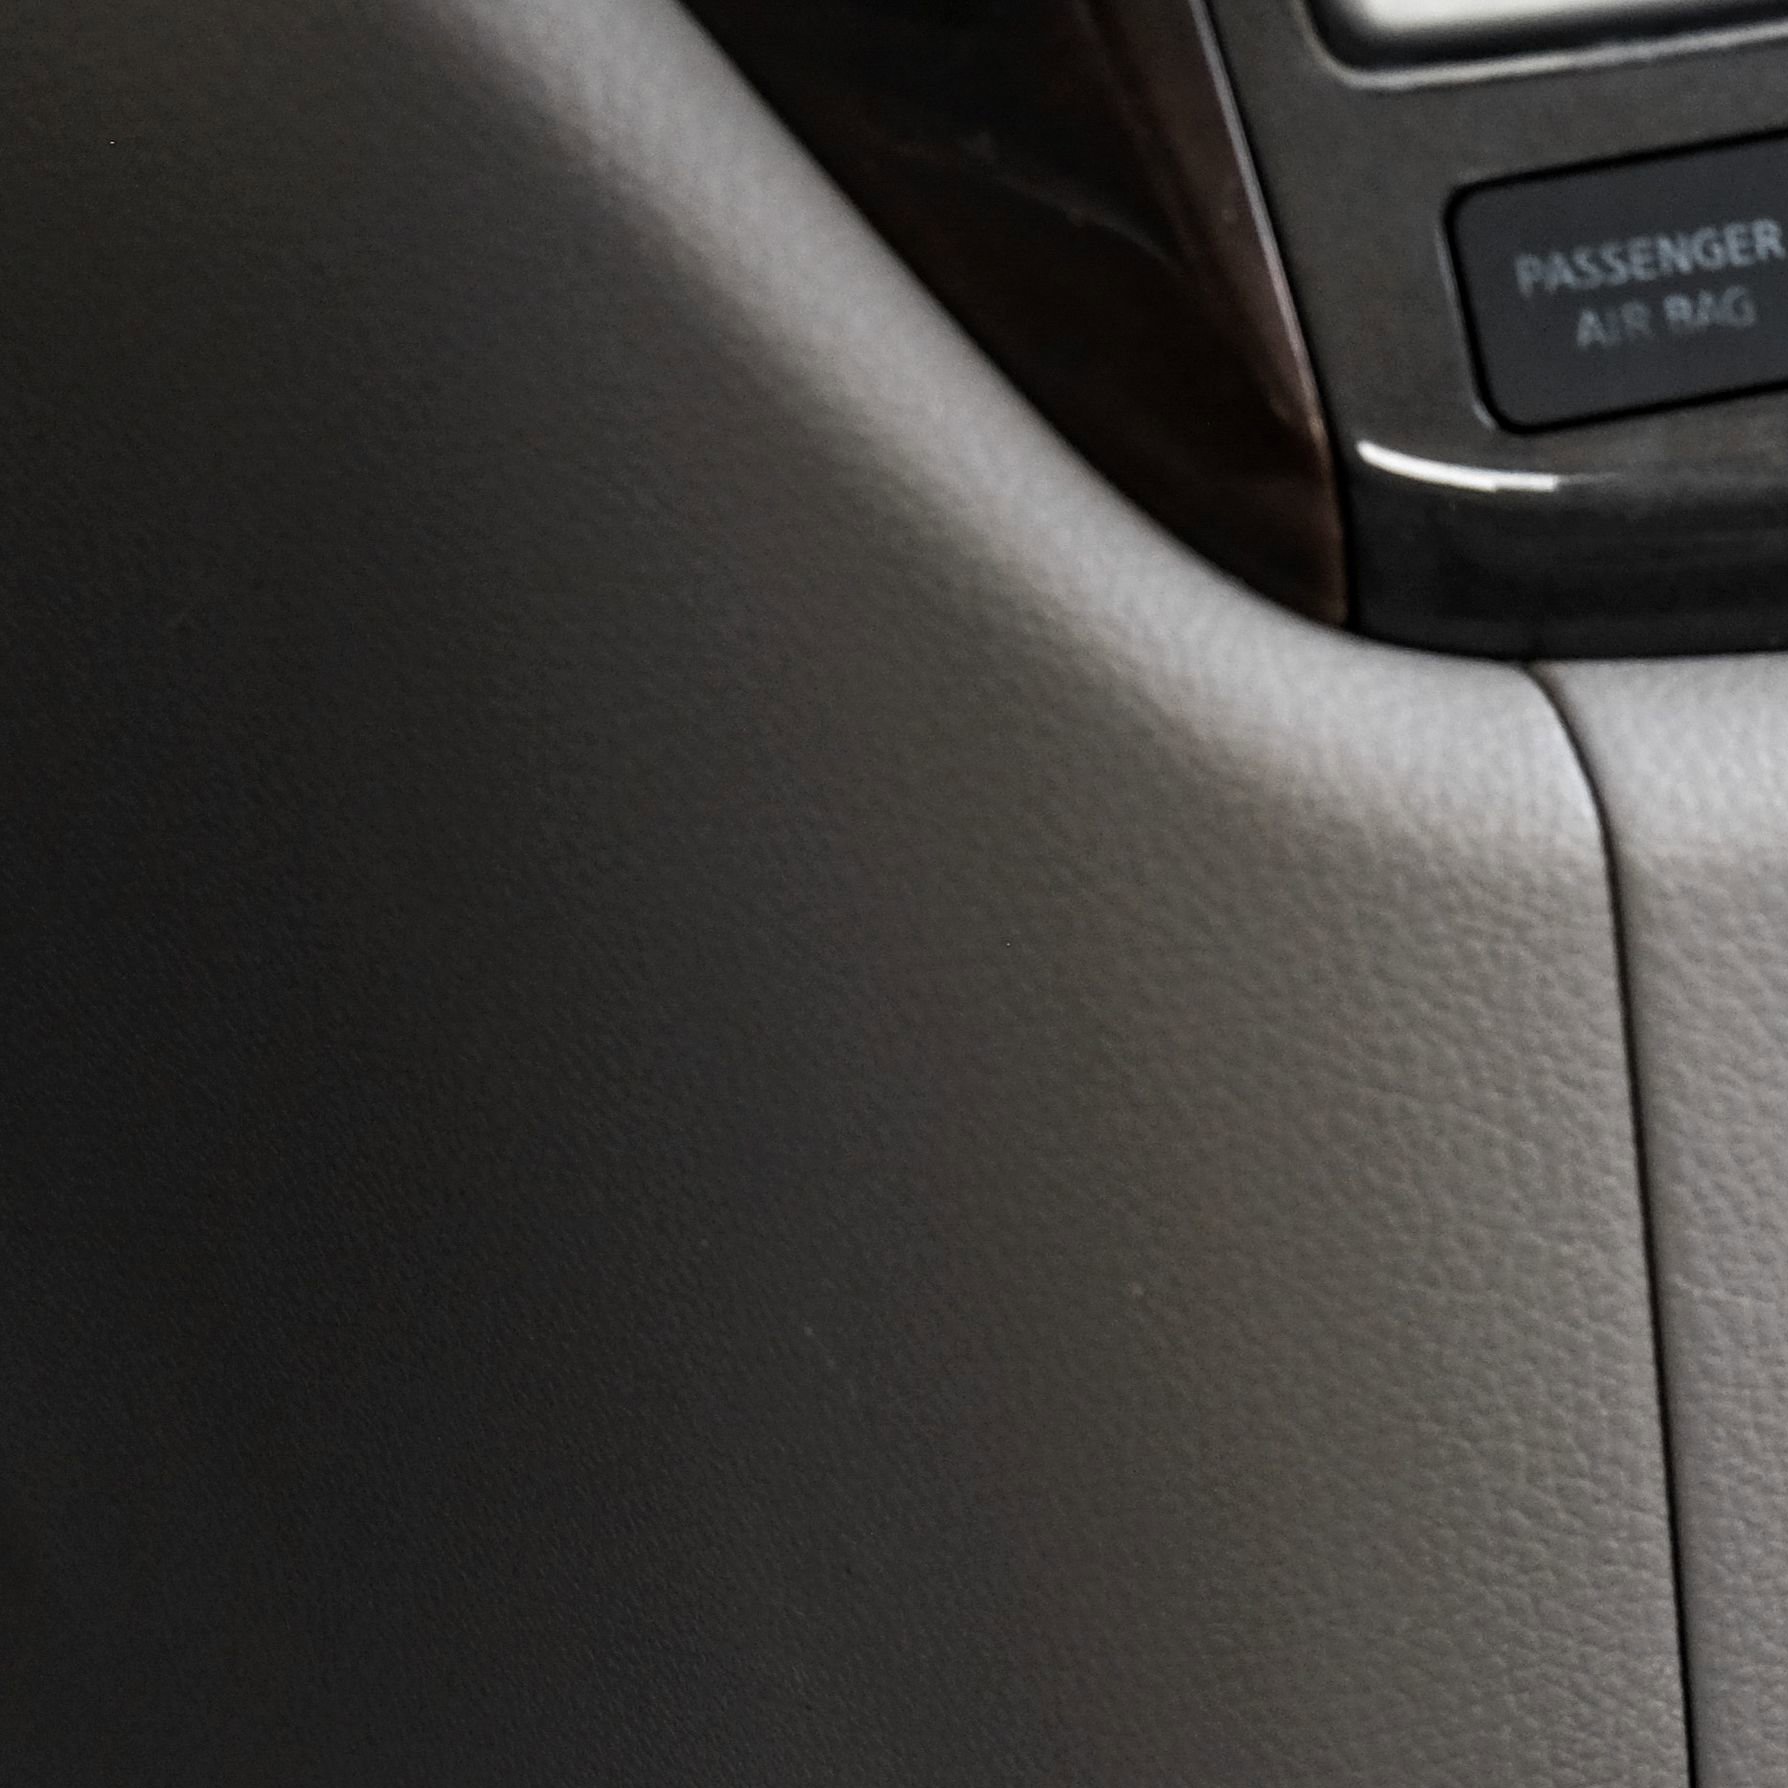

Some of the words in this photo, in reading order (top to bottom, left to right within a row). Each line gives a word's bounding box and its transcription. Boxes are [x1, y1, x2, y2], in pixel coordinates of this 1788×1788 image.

[1513, 217, 1787, 297] PASSENGER
[1577, 302, 1656, 351] AIR
[1663, 285, 1757, 338] BAG
